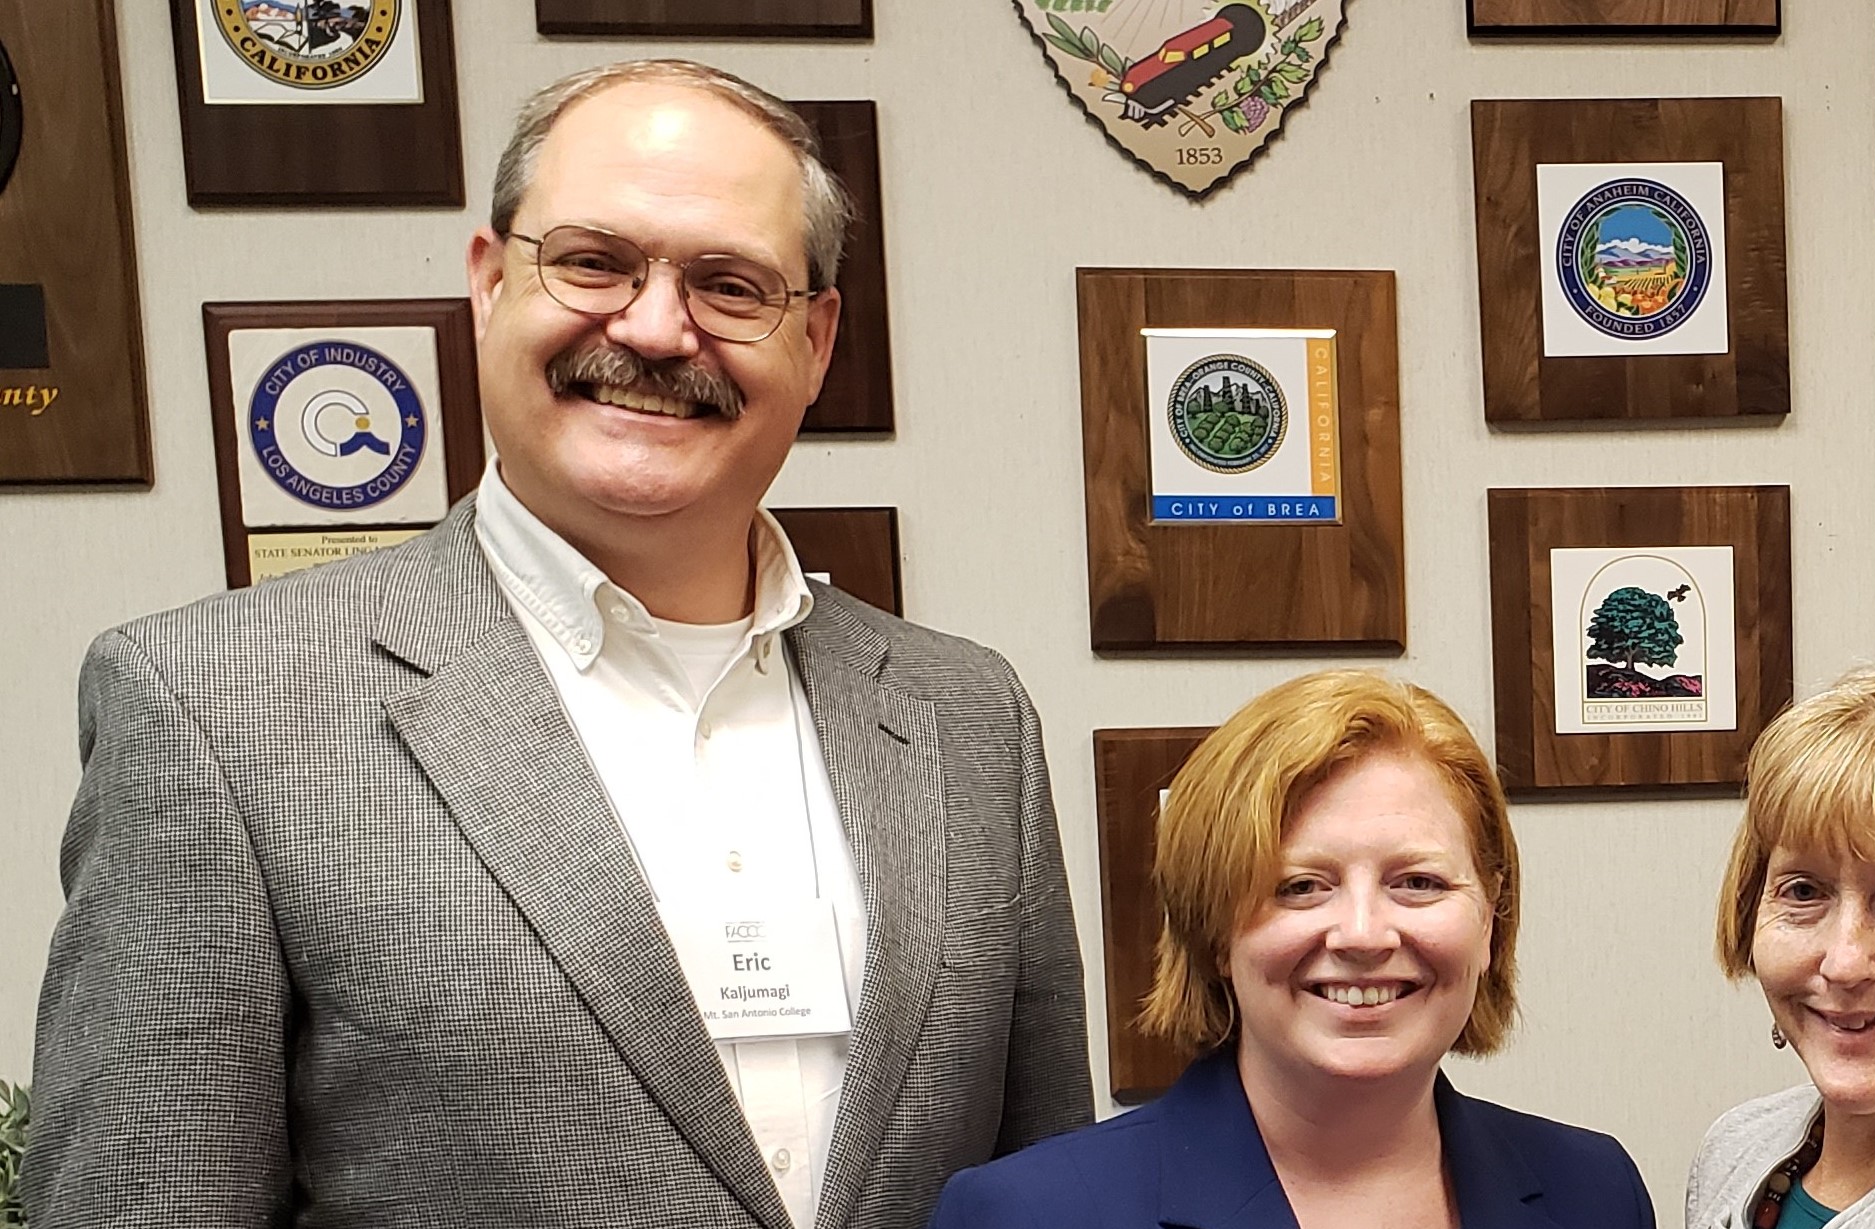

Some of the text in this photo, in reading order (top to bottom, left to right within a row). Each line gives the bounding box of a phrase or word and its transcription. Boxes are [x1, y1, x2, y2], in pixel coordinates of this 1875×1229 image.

[240, 37, 381, 81] CALIFORNIA
[1176, 147, 1223, 165] 1853
[1563, 185, 1706, 267] CITY OF ANAHEIM CALIFORNIA
[1584, 304, 1686, 334] FOUNDED 1857
[265, 347, 406, 395] CITY OF INDUSTRY
[0, 386, 58, 415] nty
[1314, 347, 1332, 482] CALIFORNIA
[262, 444, 416, 504] LOS ANGELES COUNTY
[1171, 503, 1320, 516] CITY of BREA
[321, 535, 378, 544] Presented to
[255, 547, 285, 558] STATE
[290, 546, 342, 557] SENATOR
[1586, 703, 1703, 714] CITY OF CHINO HILLS
[733, 952, 771, 971] Eric
[720, 984, 790, 1002] Kaljumagi
[704, 1007, 811, 1020] Mt. San Antonio College
